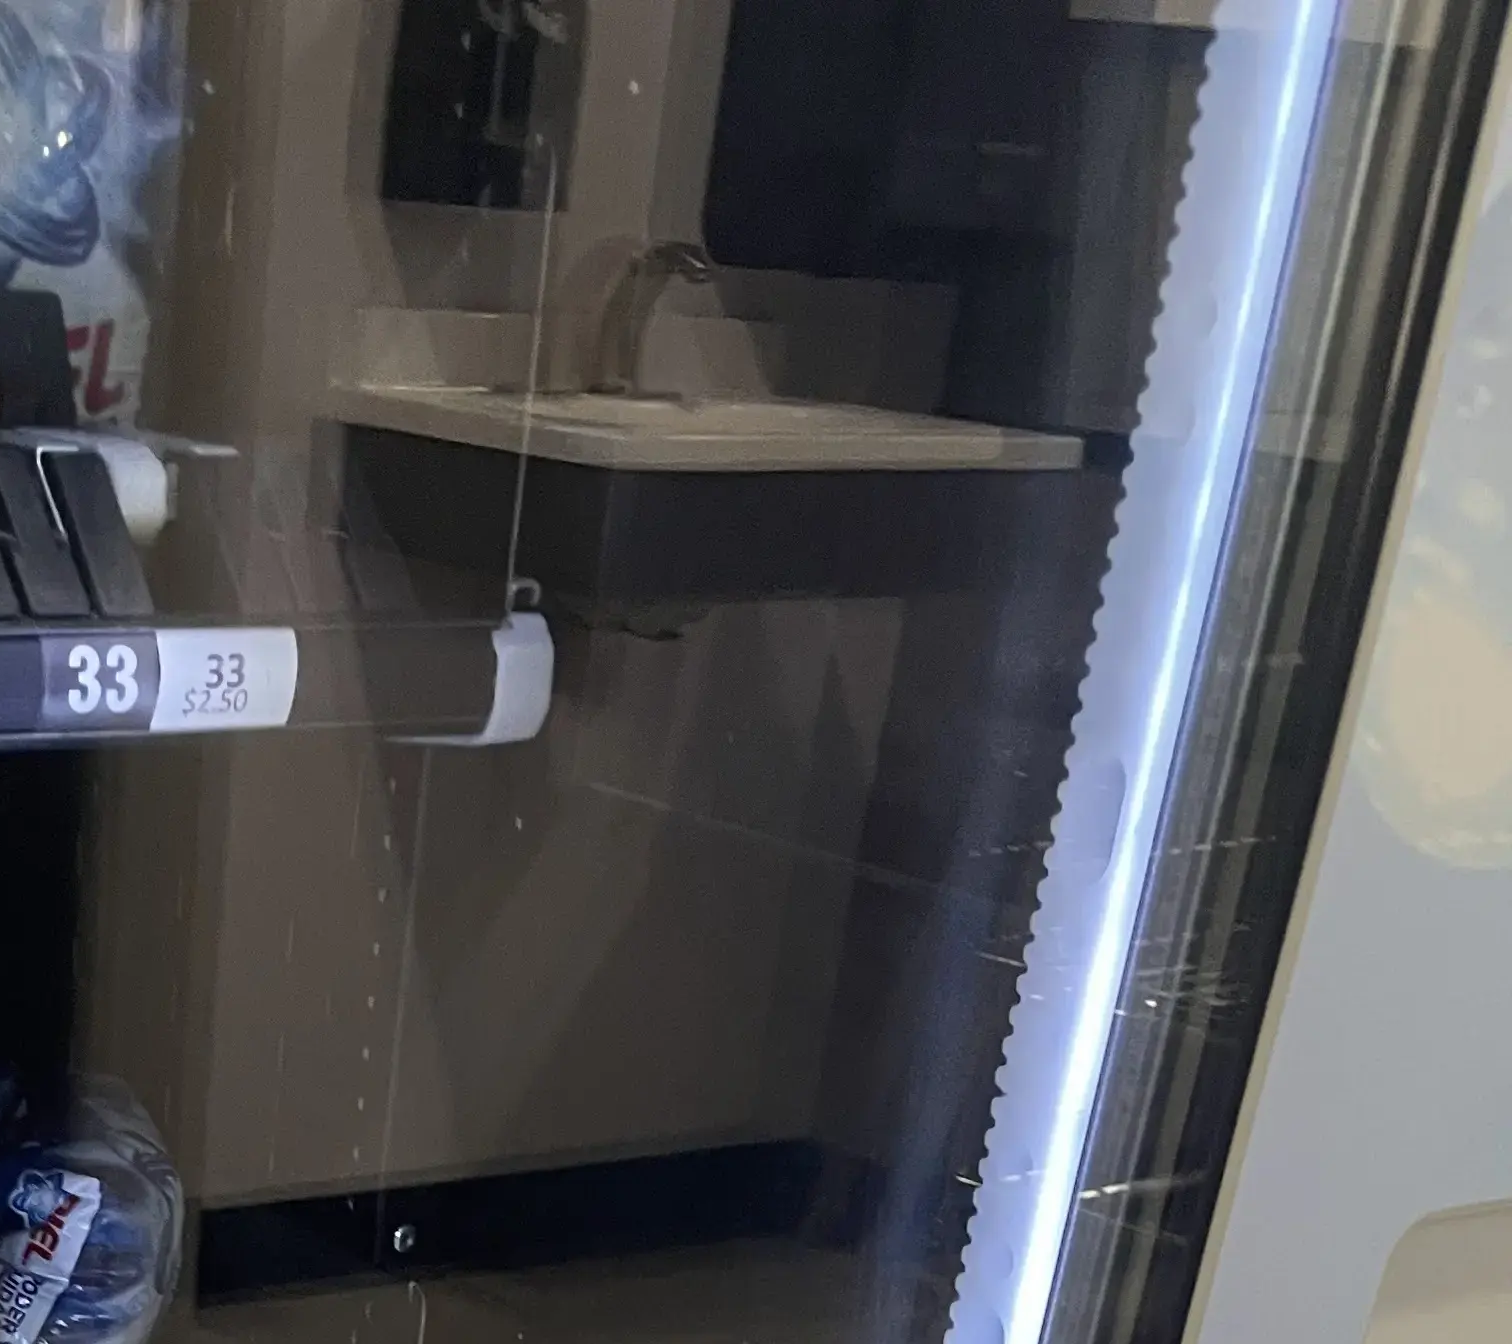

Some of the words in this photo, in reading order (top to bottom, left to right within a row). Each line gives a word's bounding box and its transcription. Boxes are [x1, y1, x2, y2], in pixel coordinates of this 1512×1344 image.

[68, 644, 138, 714] 33
[204, 654, 245, 689] 33
[181, 688, 248, 715] $2.50
